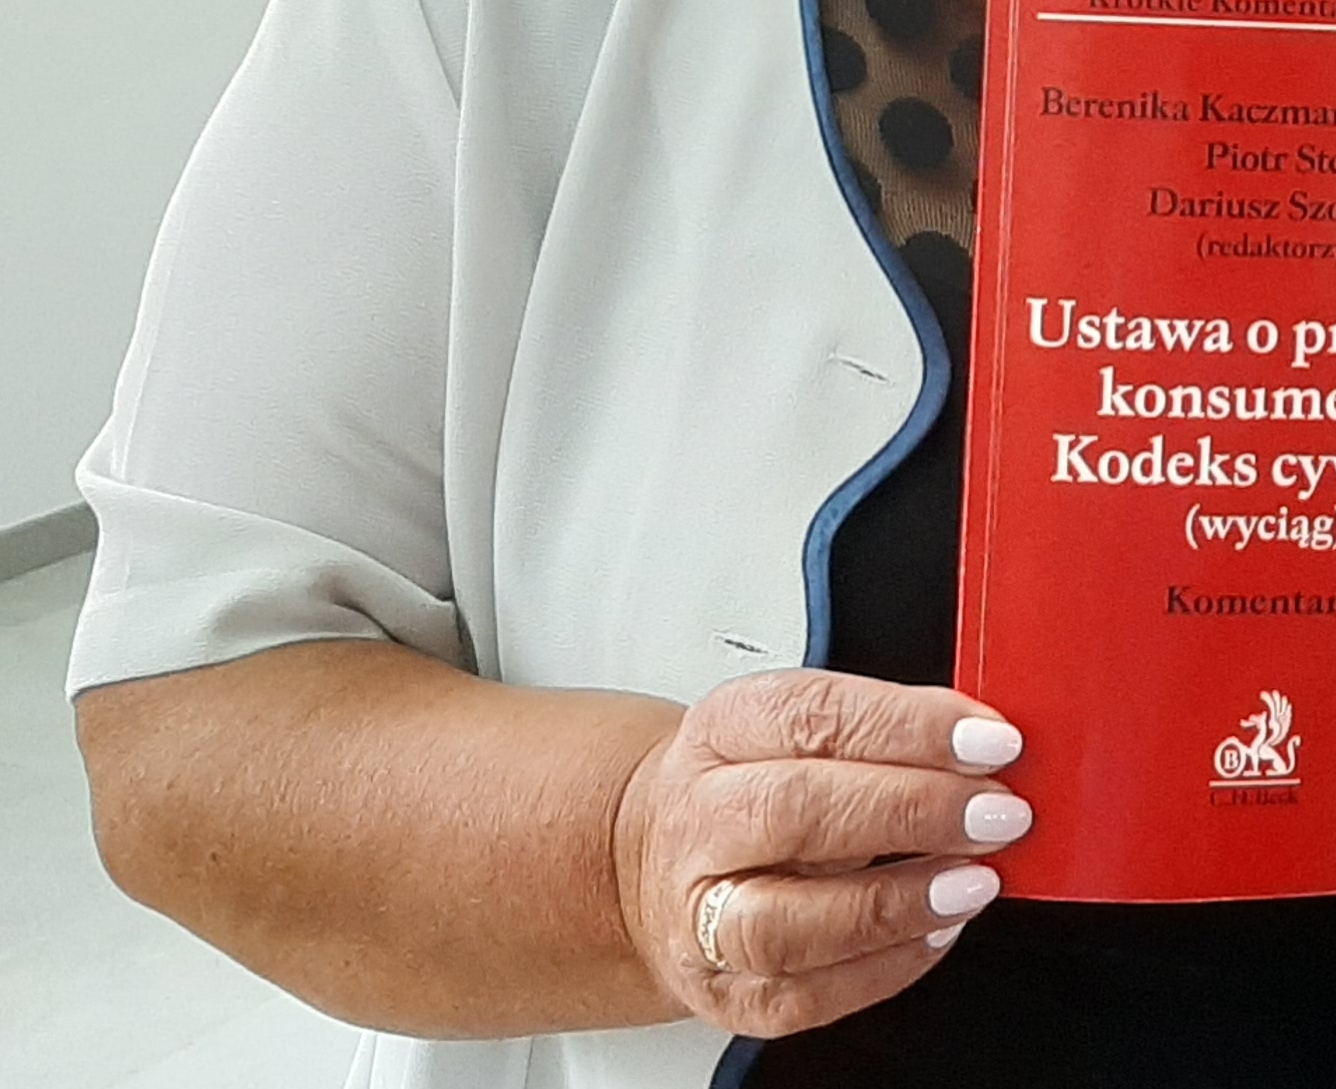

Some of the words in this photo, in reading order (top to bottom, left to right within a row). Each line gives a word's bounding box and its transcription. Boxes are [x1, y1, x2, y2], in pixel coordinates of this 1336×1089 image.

[1041, 87, 1189, 121] Berenika
[1205, 142, 1288, 171] Piotr
[1148, 187, 1281, 220] Dariusz
[1025, 297, 1233, 354] Ustawa
[1246, 319, 1279, 355] o
[1050, 434, 1258, 488] Kodeks
[1224, 749, 1238, 769] B
